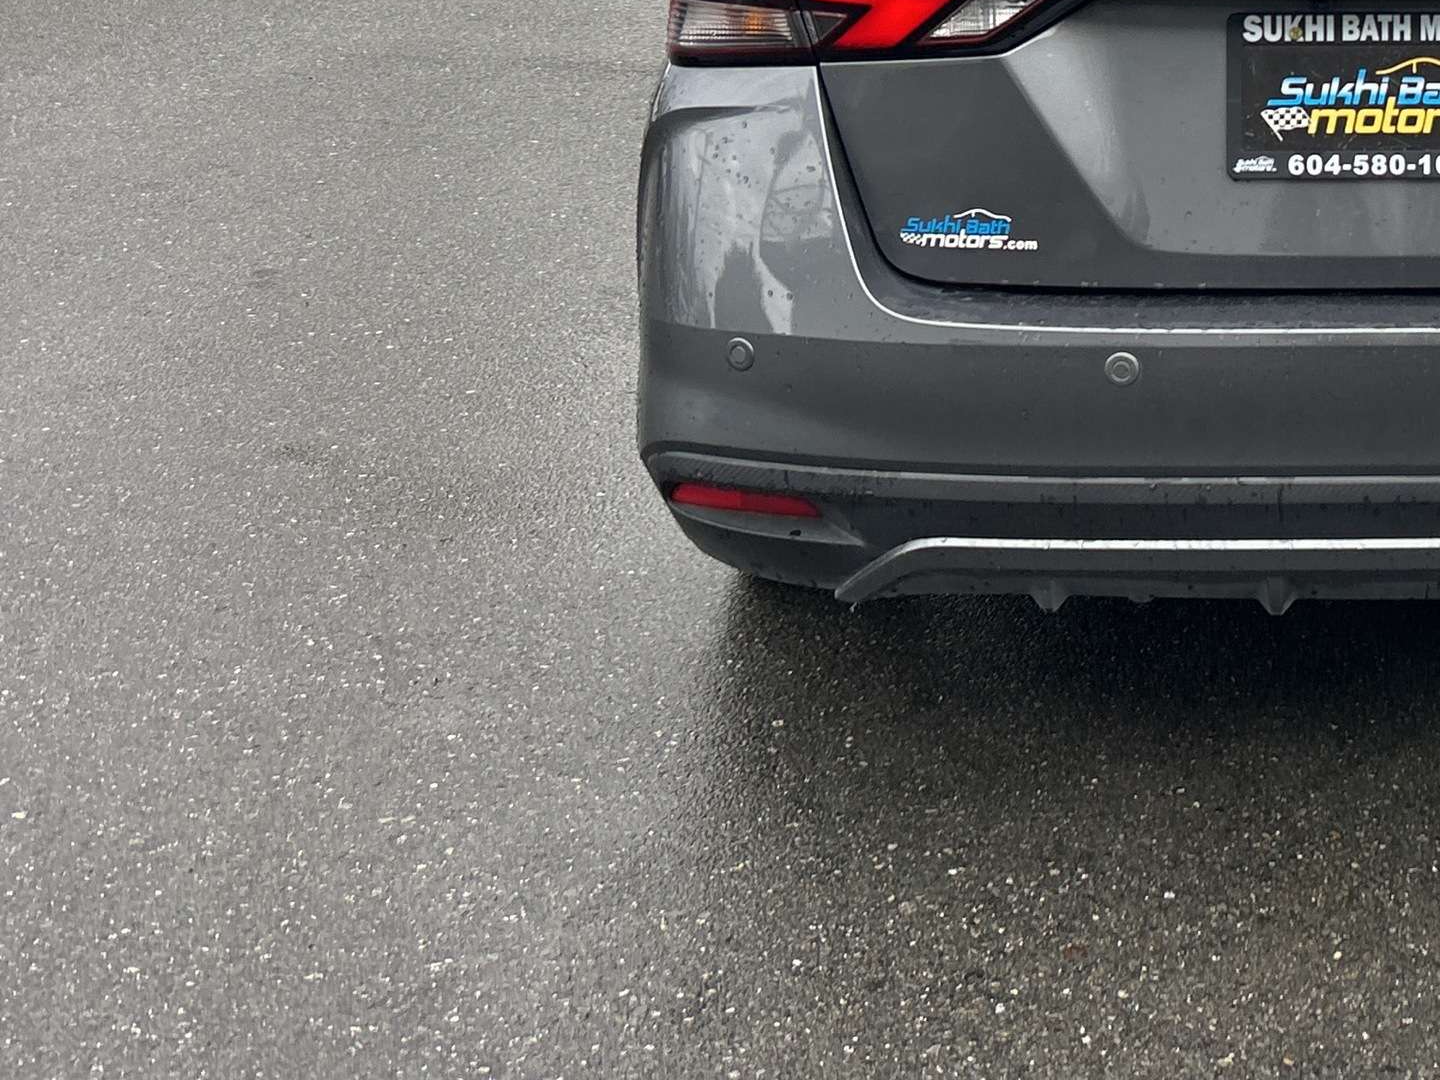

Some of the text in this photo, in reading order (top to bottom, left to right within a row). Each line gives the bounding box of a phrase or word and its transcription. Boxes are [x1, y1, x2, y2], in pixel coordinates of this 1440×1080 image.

[1242, 14, 1335, 43] SUKHI
[1342, 14, 1413, 42] BATH
[1267, 68, 1389, 106] Sukhi
[901, 215, 1011, 234] Sukhi Bath
